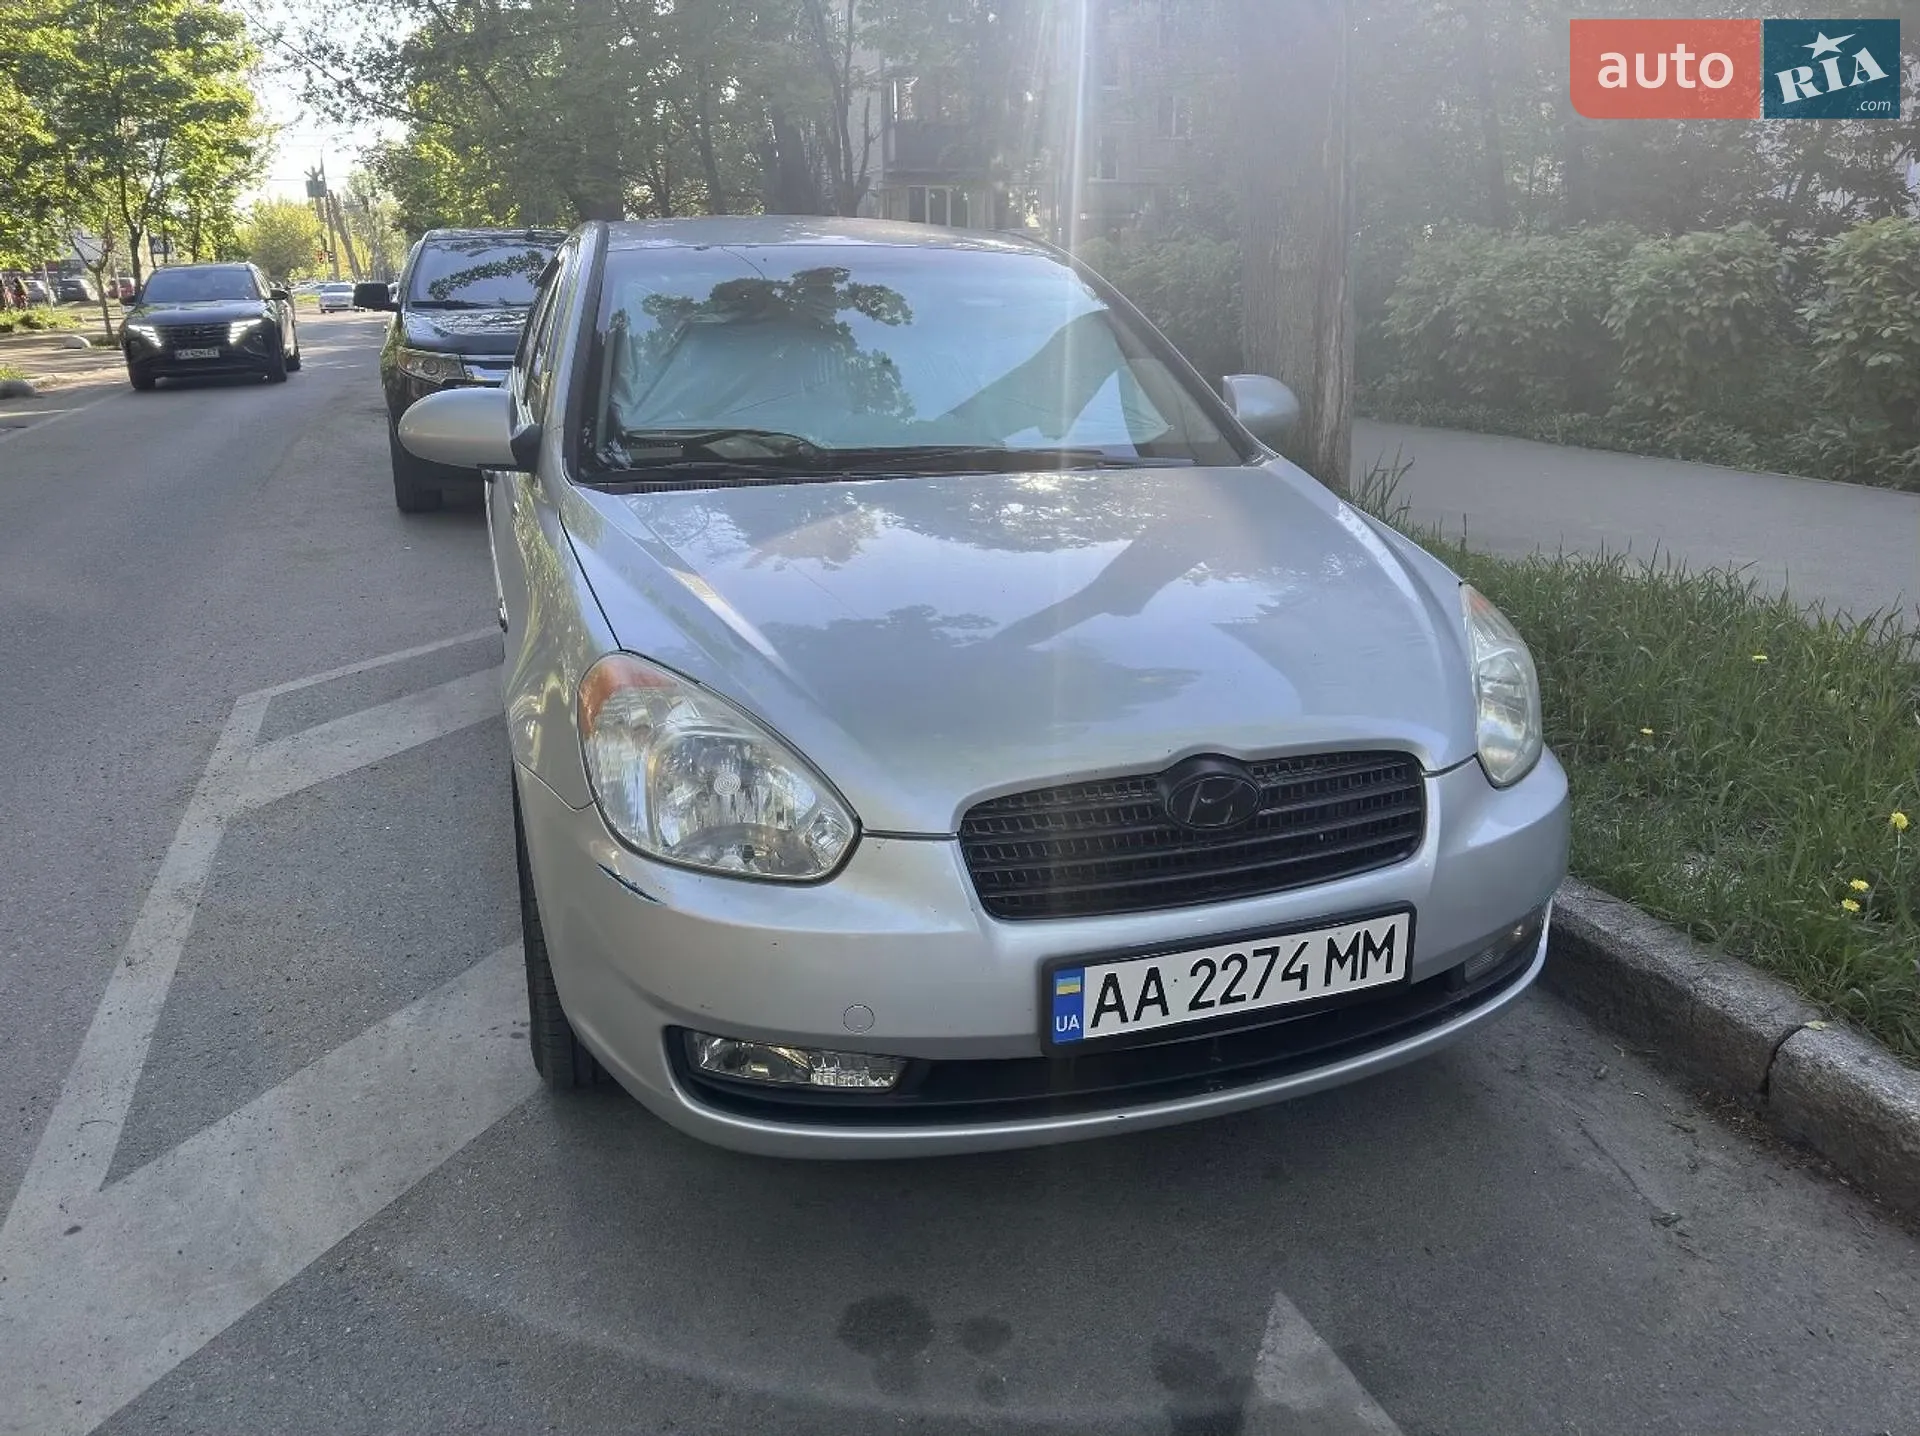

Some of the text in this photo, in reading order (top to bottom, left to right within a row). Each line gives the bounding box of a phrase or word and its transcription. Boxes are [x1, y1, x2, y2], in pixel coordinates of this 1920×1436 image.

[1090, 924, 1396, 1028] AA 2274 MM
[1055, 1014, 1081, 1032] UA
